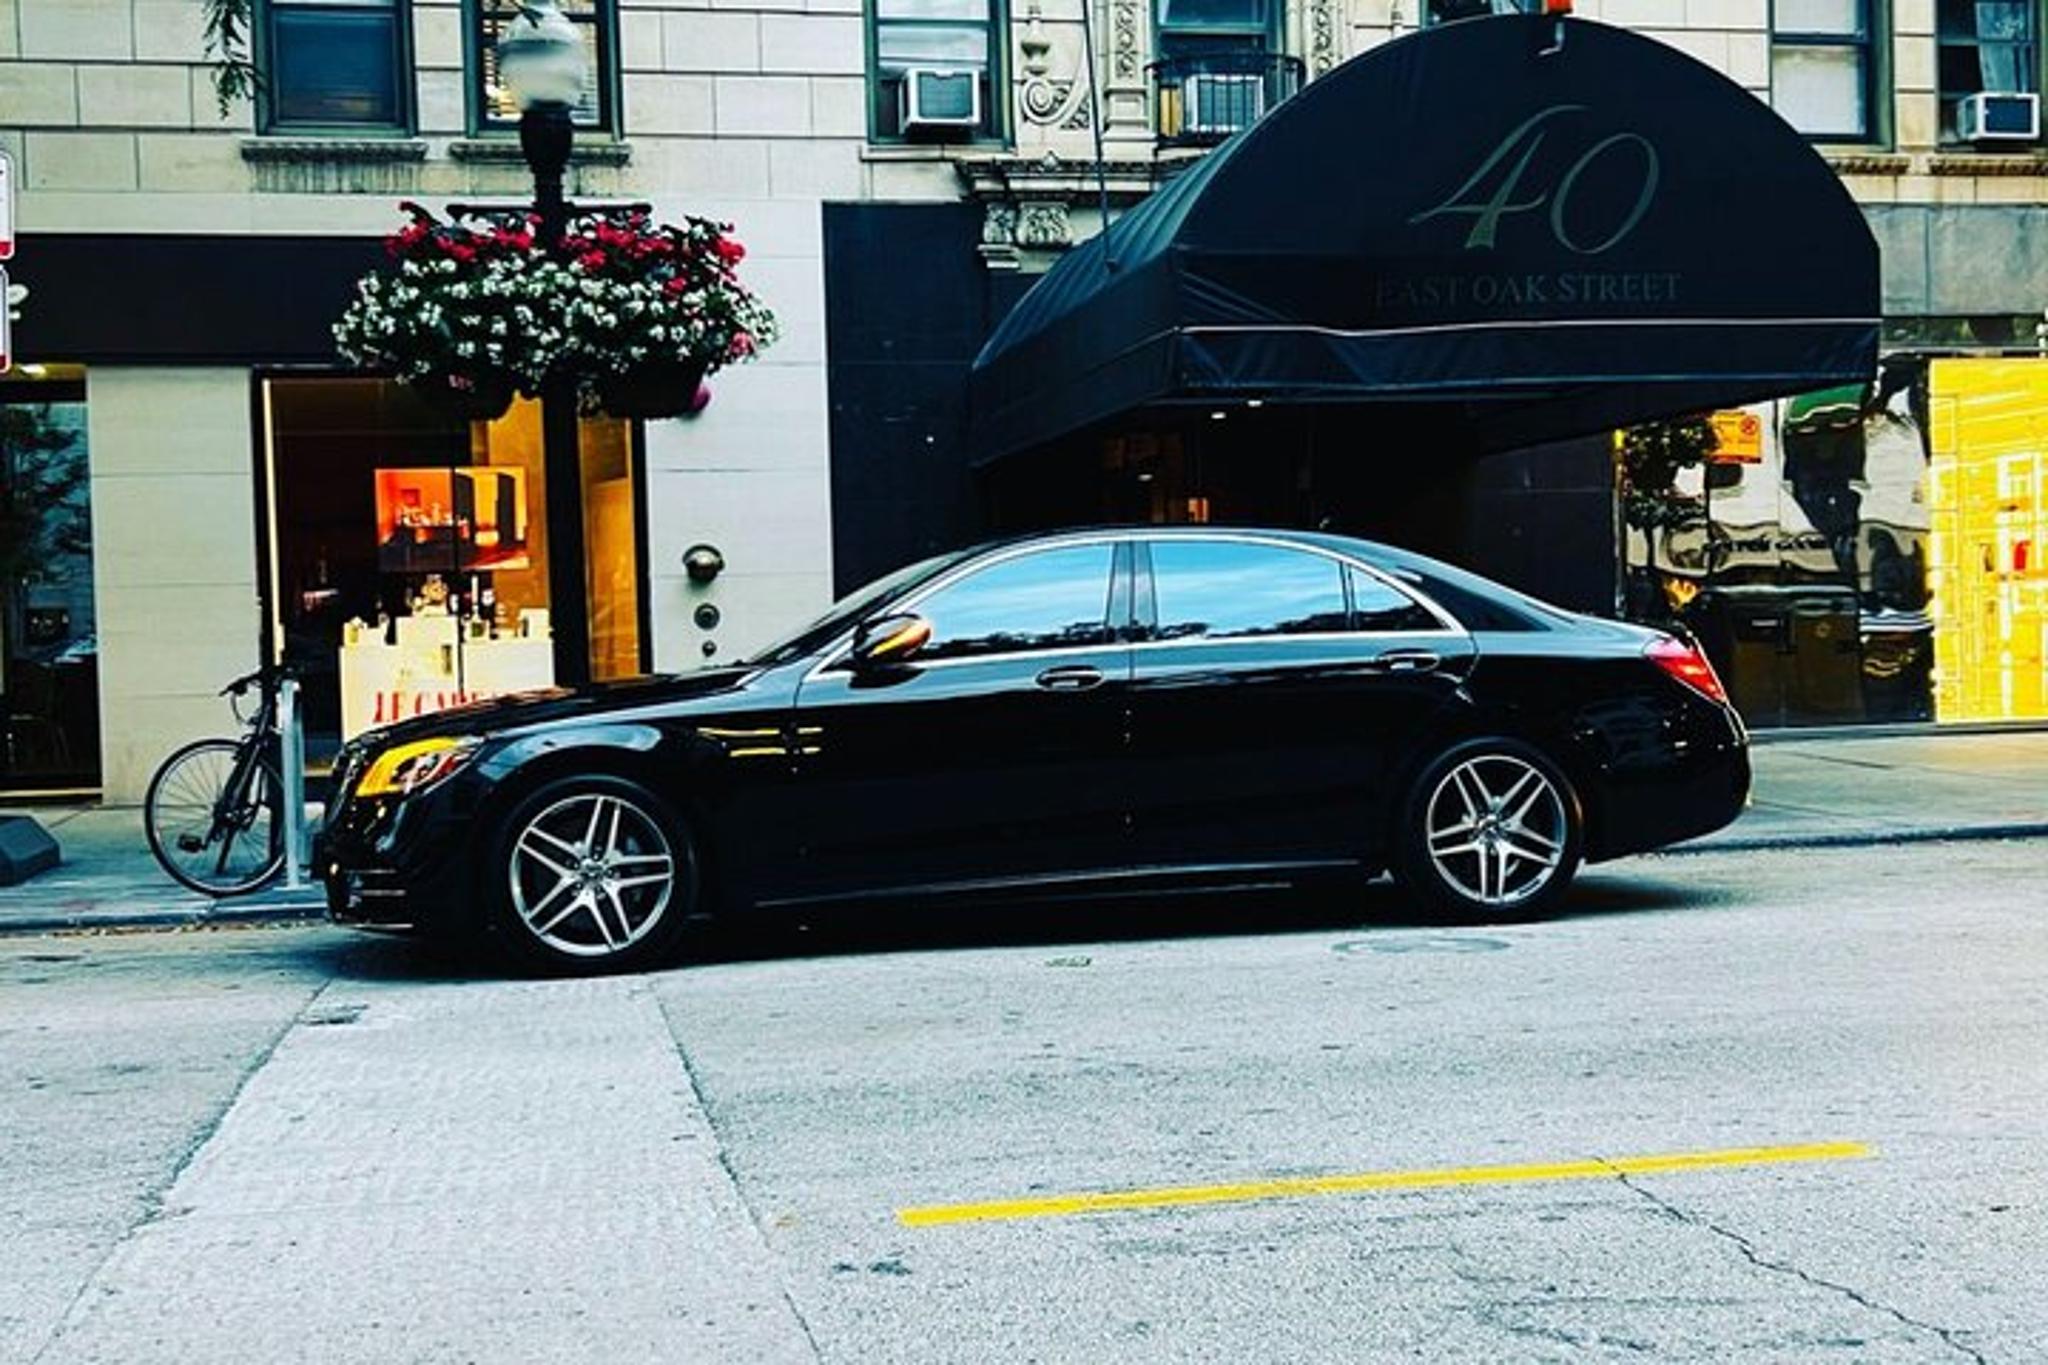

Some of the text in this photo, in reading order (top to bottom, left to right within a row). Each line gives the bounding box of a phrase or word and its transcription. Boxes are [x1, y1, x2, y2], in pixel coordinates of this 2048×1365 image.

[1408, 104, 1660, 254] 40
[1377, 273, 1682, 306] EAST OAK STREET
